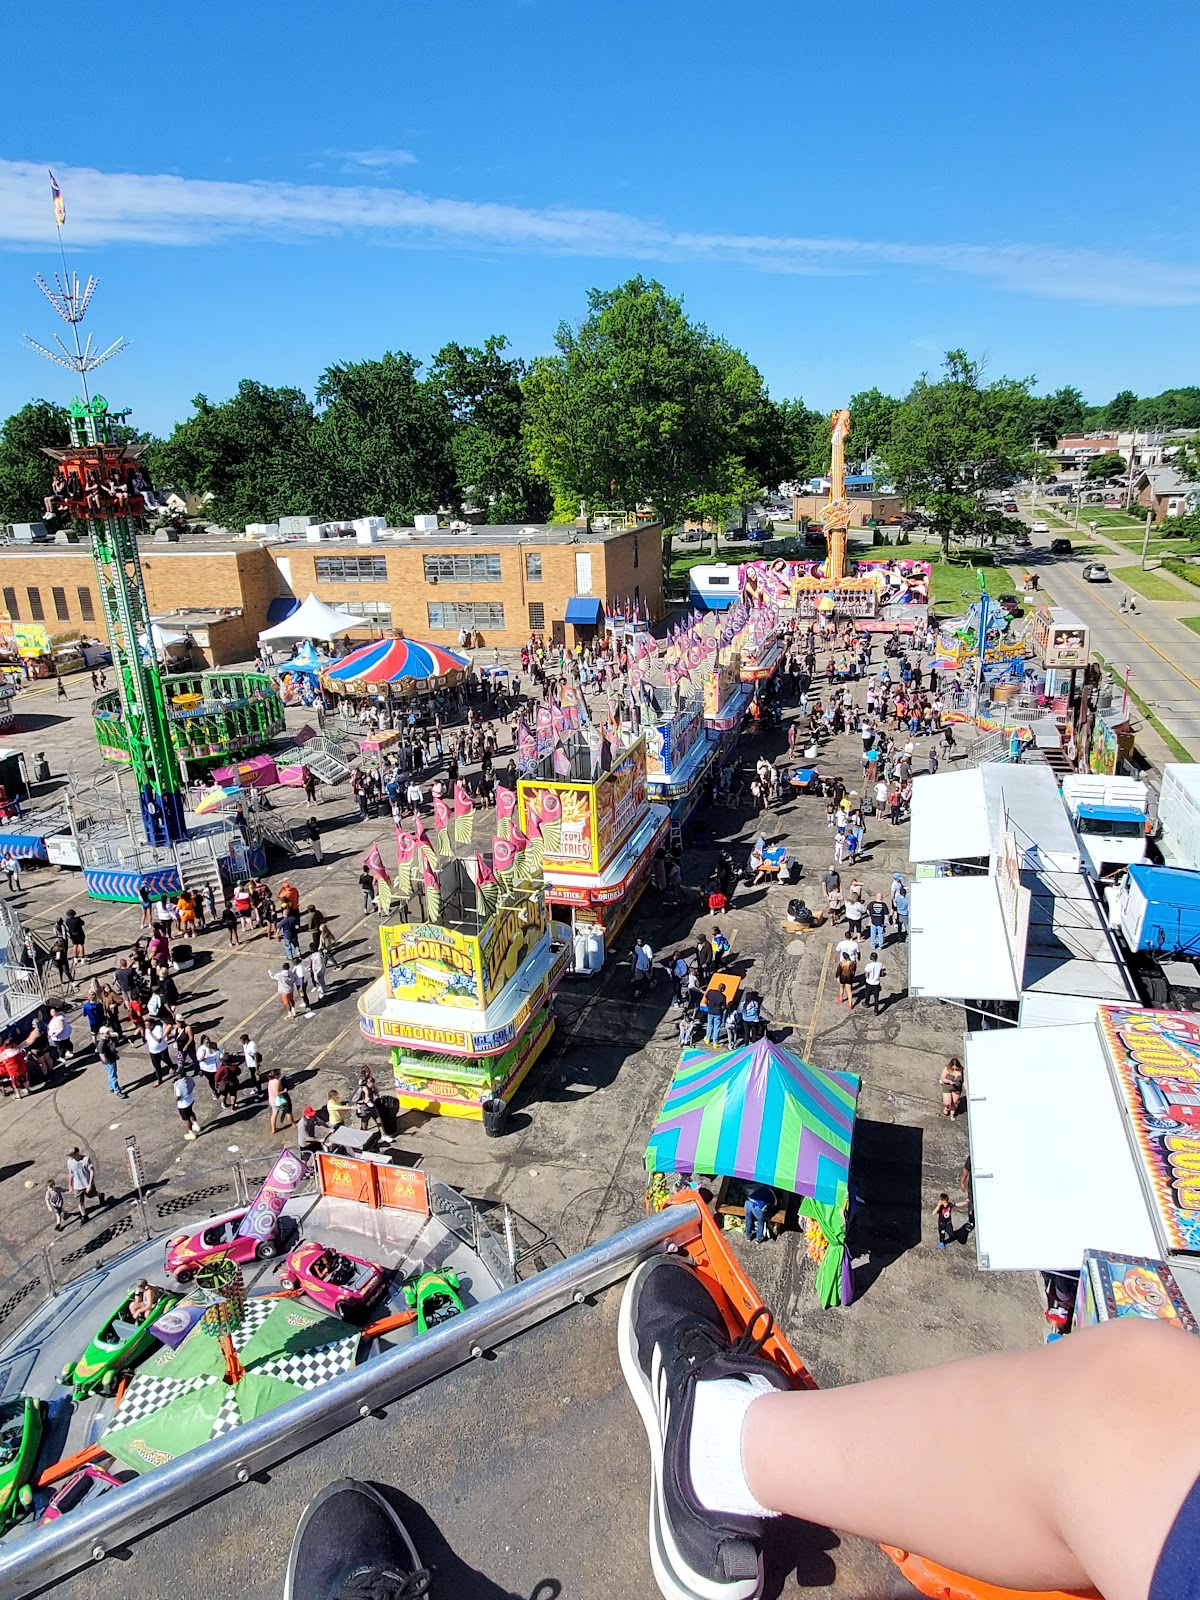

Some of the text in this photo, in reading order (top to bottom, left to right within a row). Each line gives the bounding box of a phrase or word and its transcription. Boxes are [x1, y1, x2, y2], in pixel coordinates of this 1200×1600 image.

[564, 833, 578, 842] CUT
[564, 843, 588, 857] FRIES
[563, 891, 580, 899] STICK
[390, 940, 473, 977] LEMONADE
[418, 973, 446, 987] LEMONADE
[383, 1022, 465, 1046] LEMONADE
[474, 1024, 513, 1045] ICE COLD
[1117, 1032, 1200, 1083] HOT
